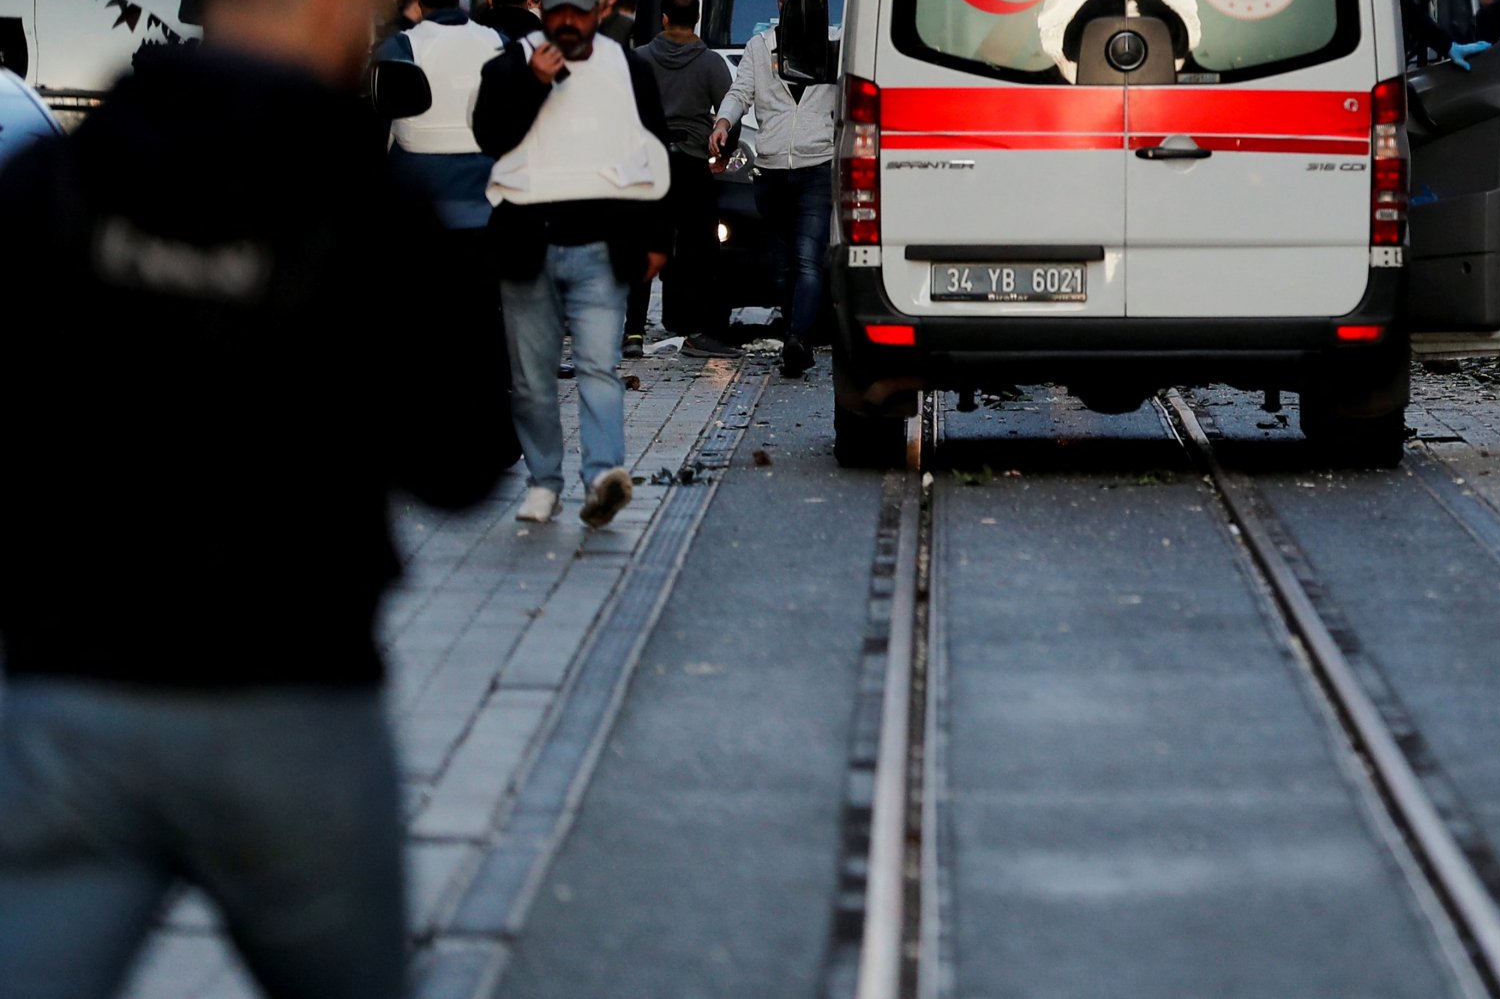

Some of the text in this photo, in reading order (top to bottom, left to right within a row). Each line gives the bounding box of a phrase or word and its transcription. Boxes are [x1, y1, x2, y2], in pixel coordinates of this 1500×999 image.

[947, 268, 1082, 292] 34 YB 6021
